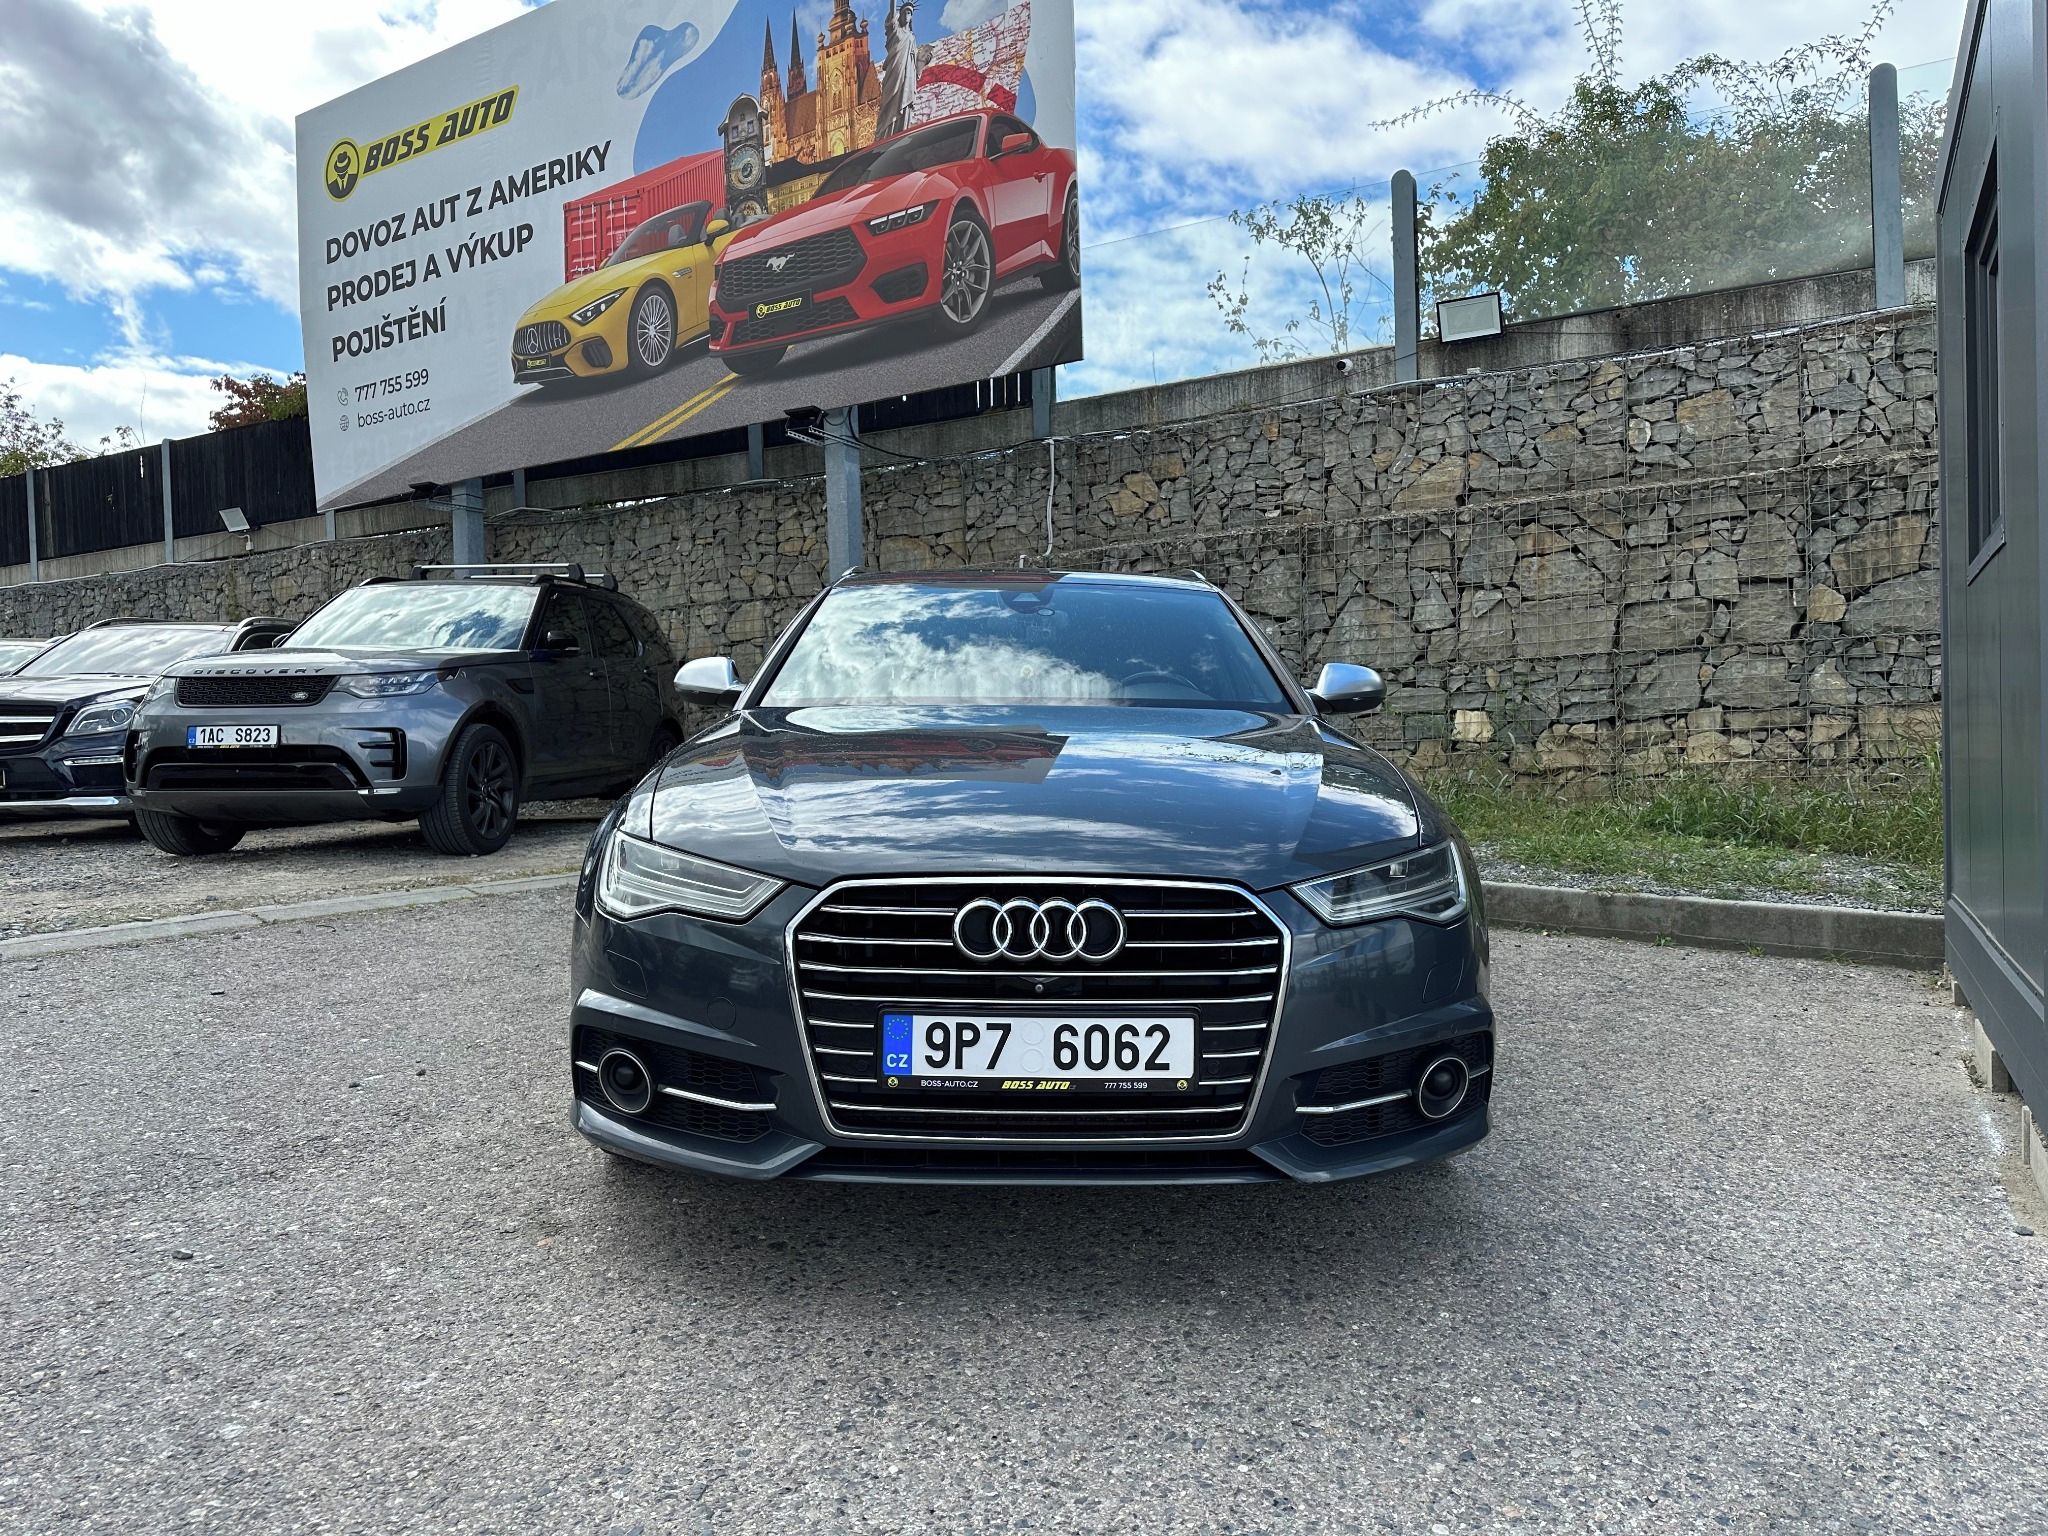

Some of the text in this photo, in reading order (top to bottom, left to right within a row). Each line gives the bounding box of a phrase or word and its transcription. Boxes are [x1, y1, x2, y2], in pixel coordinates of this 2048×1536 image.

[363, 90, 516, 174] BOSS AUTO
[326, 139, 612, 264] DOVOZ AUT Z AMERIKY
[327, 223, 533, 311] PRODEJ A VÝKUP
[332, 296, 447, 362] POJIŠTĚNÍ
[355, 368, 429, 402] 777 755 599
[357, 398, 431, 428] boss-auto.cz
[193, 667, 326, 675] DISCOVERY
[200, 728, 224, 743] 1AC
[235, 728, 271, 743] S823
[886, 1021, 1171, 1071] CZ 9P7 6062
[920, 1080, 979, 1088] BOSS-AUTO.CZ
[1001, 1080, 1034, 1089] BOSS
[1035, 1081, 1071, 1090] AUTO
